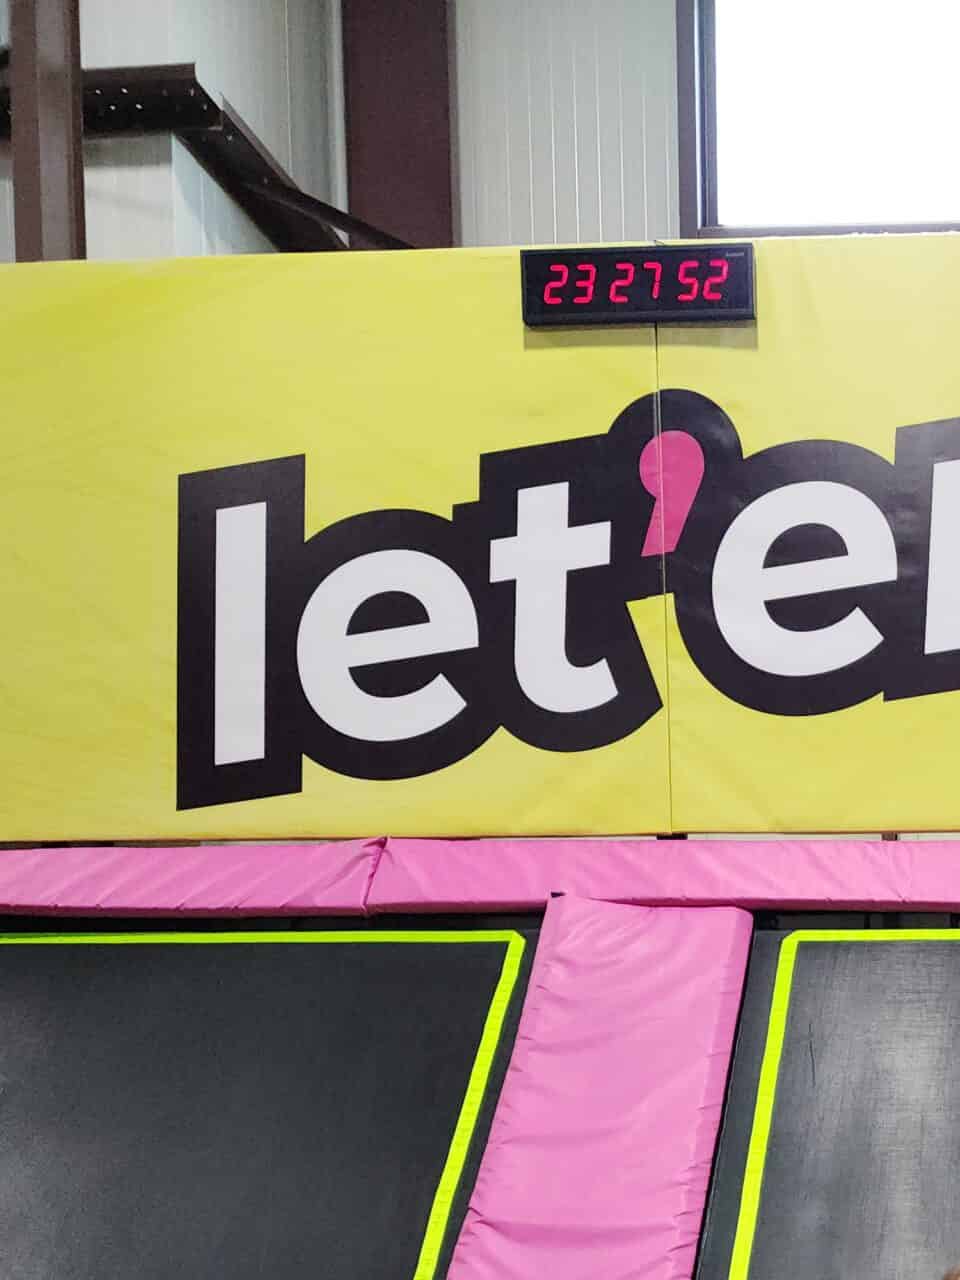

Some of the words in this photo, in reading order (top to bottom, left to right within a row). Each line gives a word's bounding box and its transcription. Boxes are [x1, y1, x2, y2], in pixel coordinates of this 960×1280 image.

[543, 263, 597, 305] 23
[609, 262, 662, 303] 27
[677, 259, 729, 301] 52
